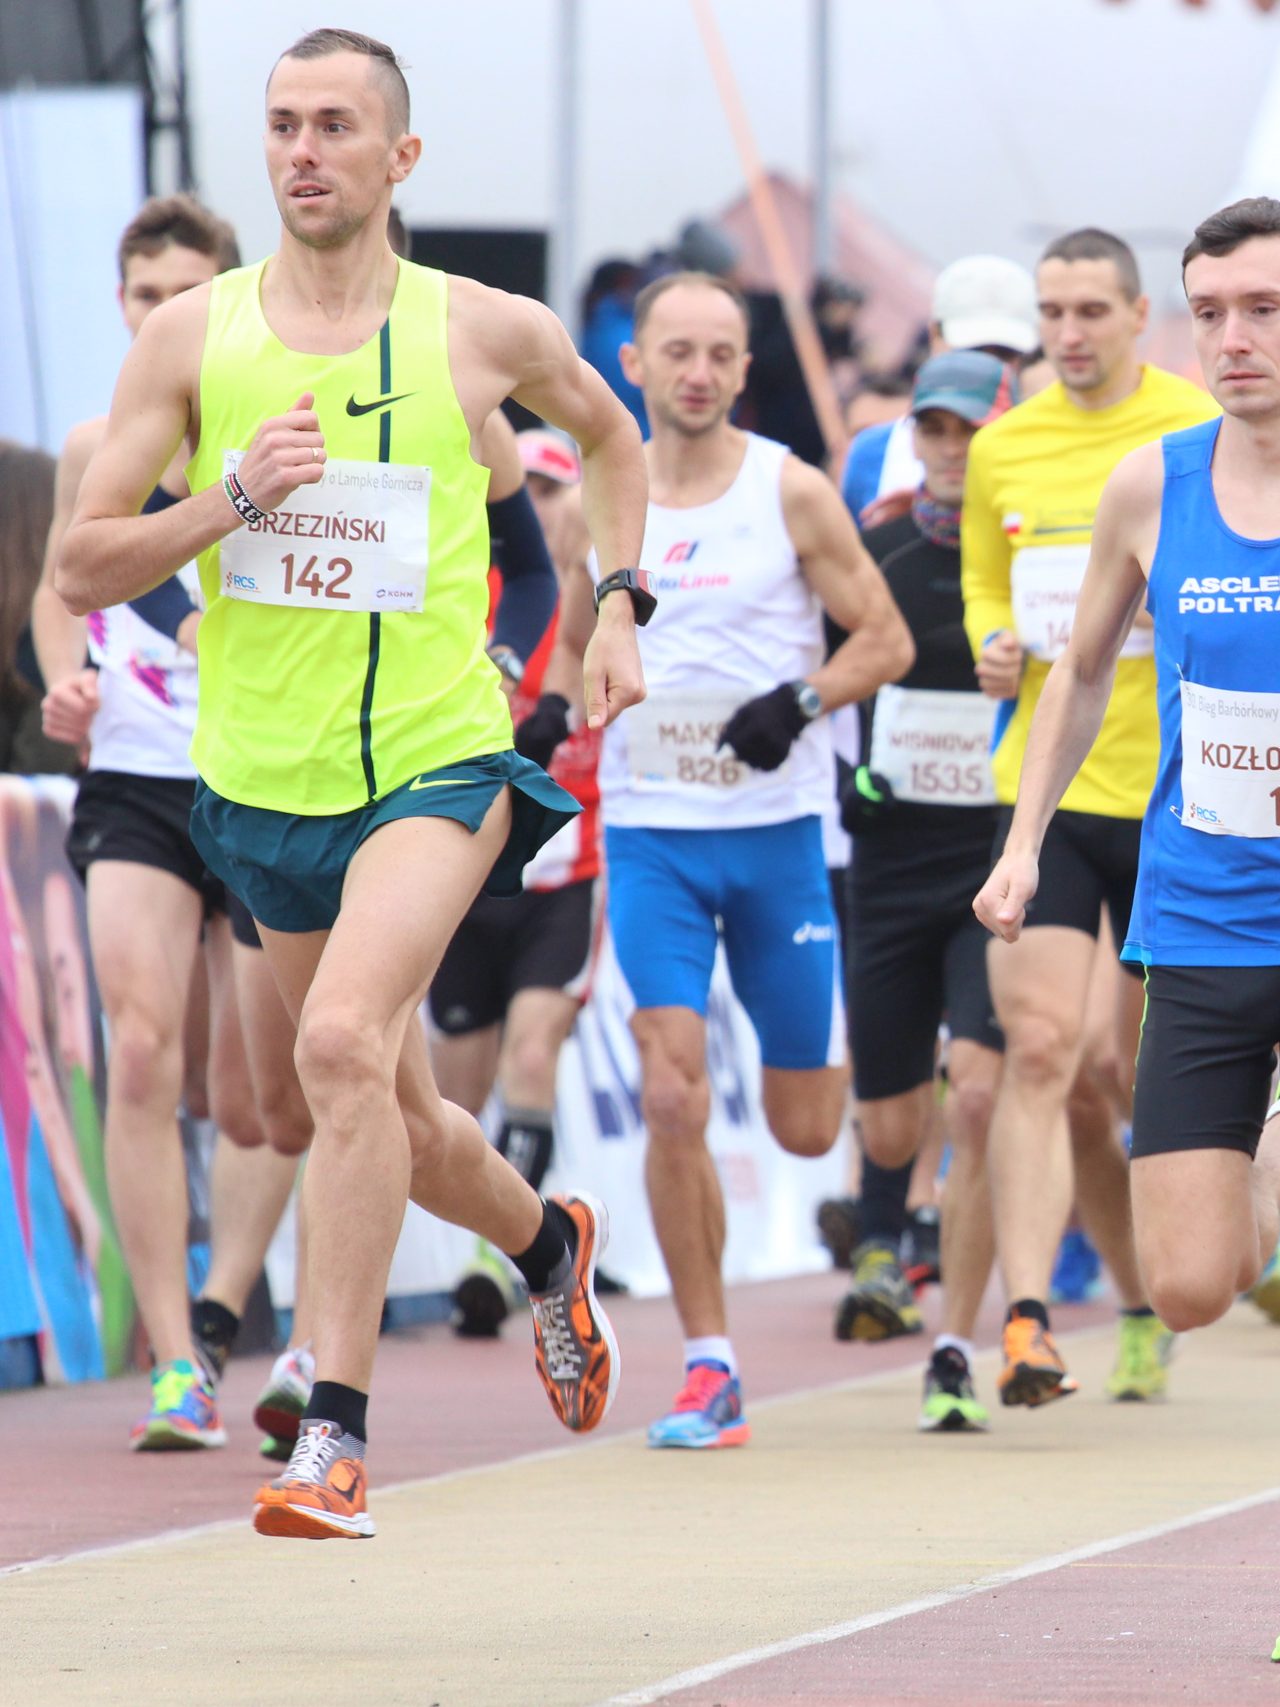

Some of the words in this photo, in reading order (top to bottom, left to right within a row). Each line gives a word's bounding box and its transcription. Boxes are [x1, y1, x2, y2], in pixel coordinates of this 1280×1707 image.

[281, 553, 353, 600] 142
[1198, 695, 1217, 718] Bieg
[1218, 700, 1279, 722] Barbórkowy
[677, 755, 740, 787] 826
[911, 761, 983, 796] 1535
